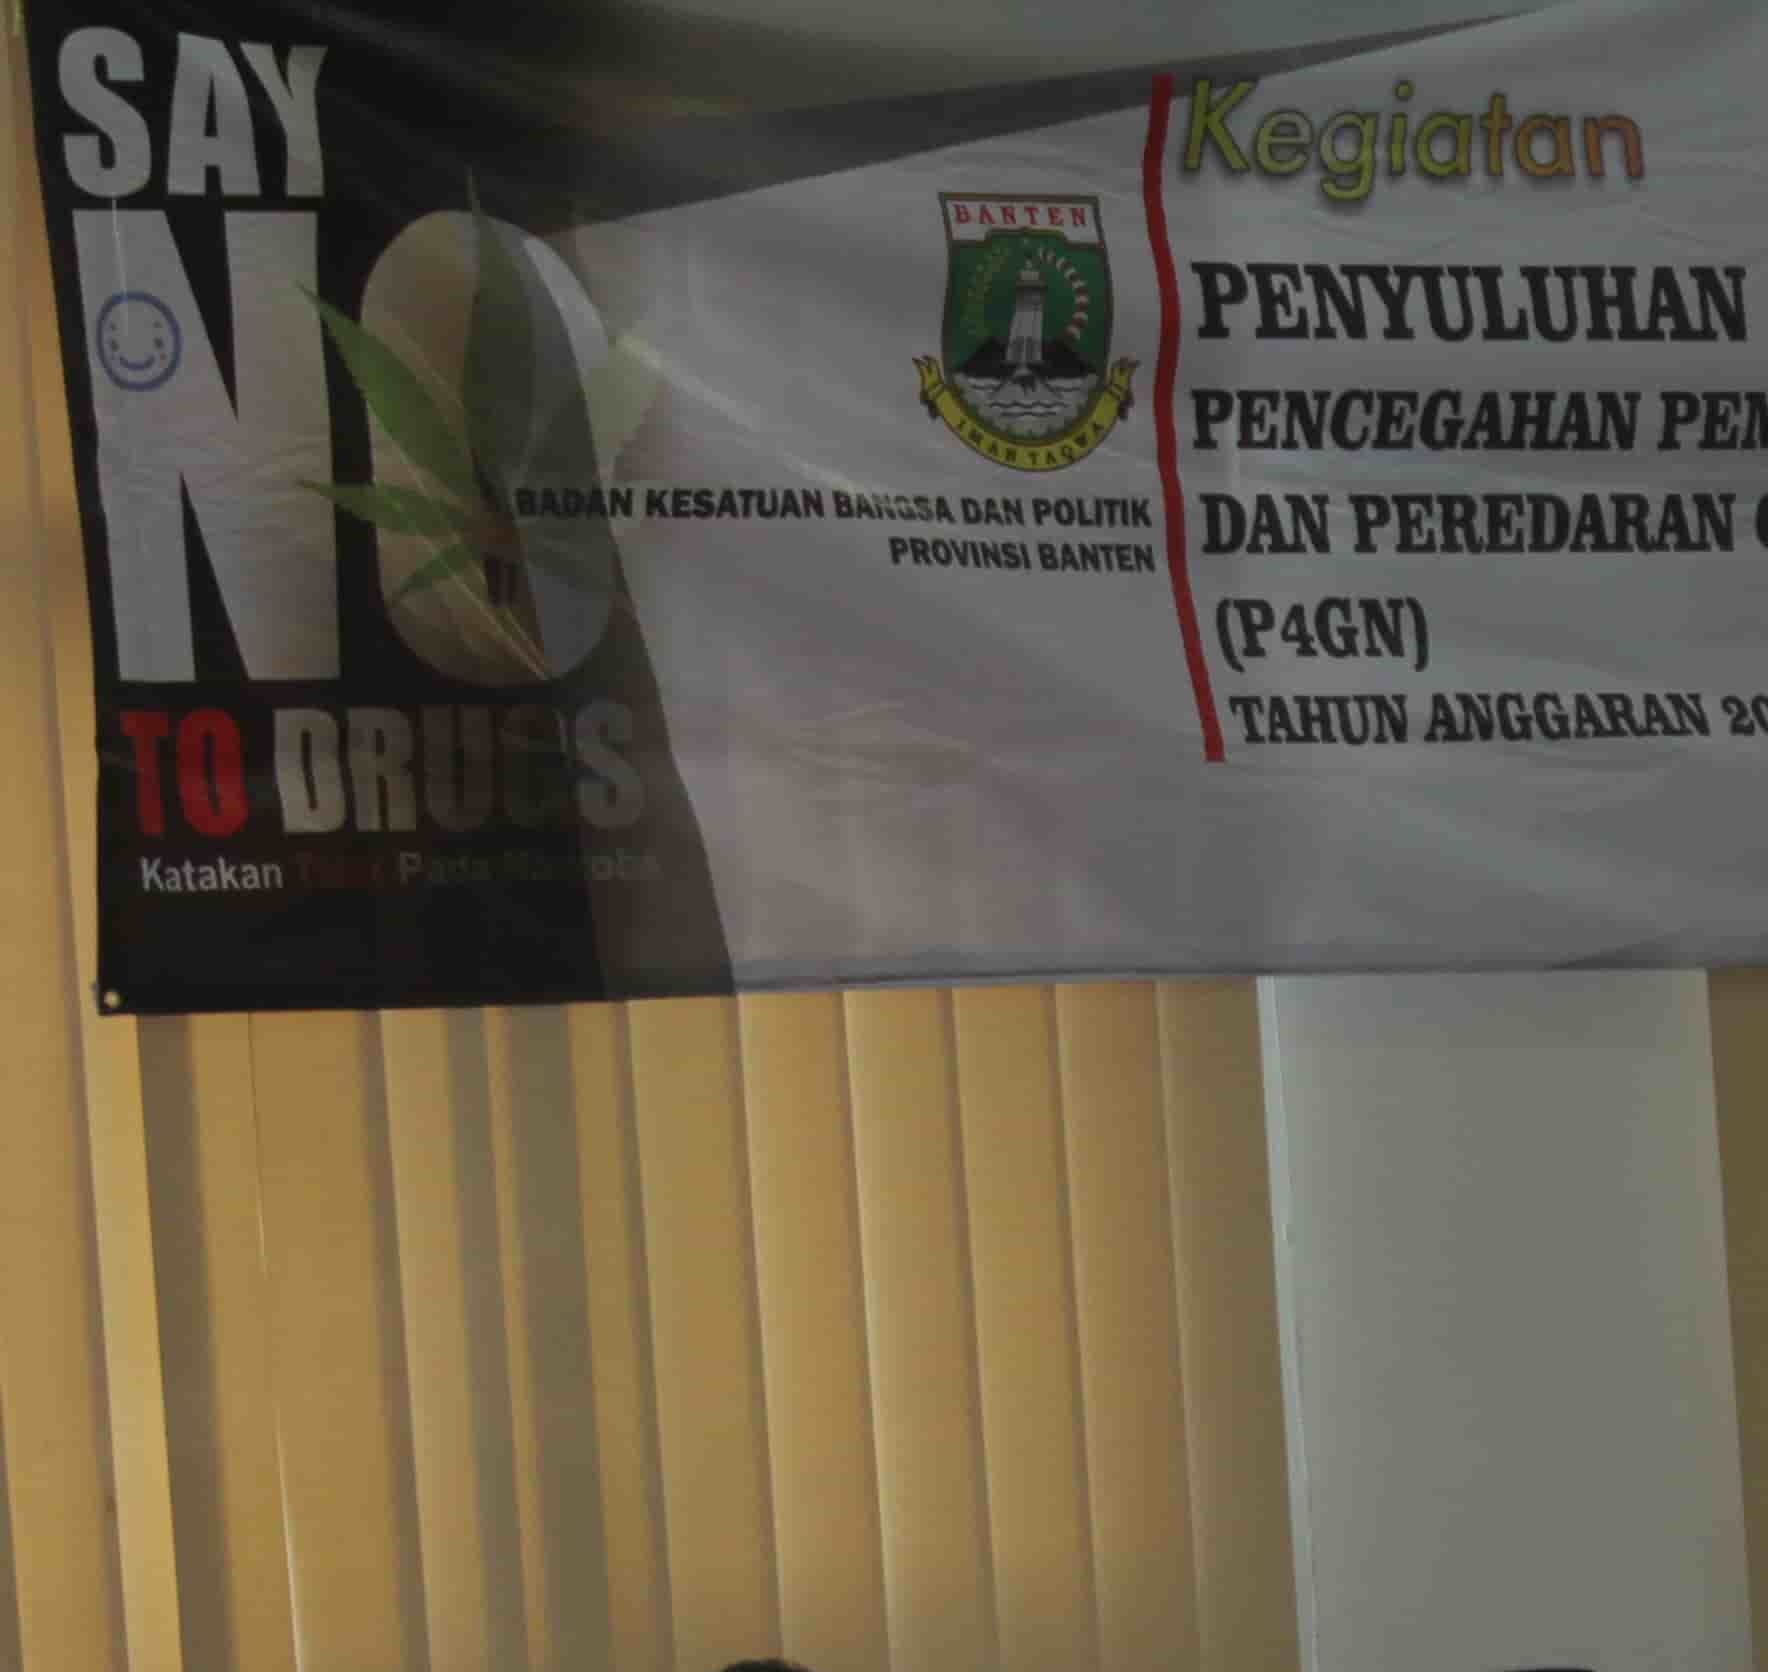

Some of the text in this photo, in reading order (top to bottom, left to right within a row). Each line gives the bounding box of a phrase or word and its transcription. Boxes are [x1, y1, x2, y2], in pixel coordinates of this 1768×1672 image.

[57, 26, 327, 199] SAY
[1182, 78, 1646, 203] Kegiatan
[952, 203, 1087, 226] BANTEN
[1191, 261, 1748, 342] PENYULUHAN
[1191, 389, 1641, 451] PENCEGAHAN
[514, 487, 1153, 529] BADAN KESATUAN BANGSA DAN POLITIK
[1200, 493, 1329, 554] DAN
[1352, 492, 1735, 554] PEREDARAN
[890, 536, 1156, 574] PROVINSI BANTEN
[1216, 597, 1430, 673] (P4GN)
[1229, 694, 1409, 746] TAHUN
[1424, 691, 1711, 744] ANGGARAN
[120, 707, 250, 839] TO
[140, 855, 284, 893] Katakan
